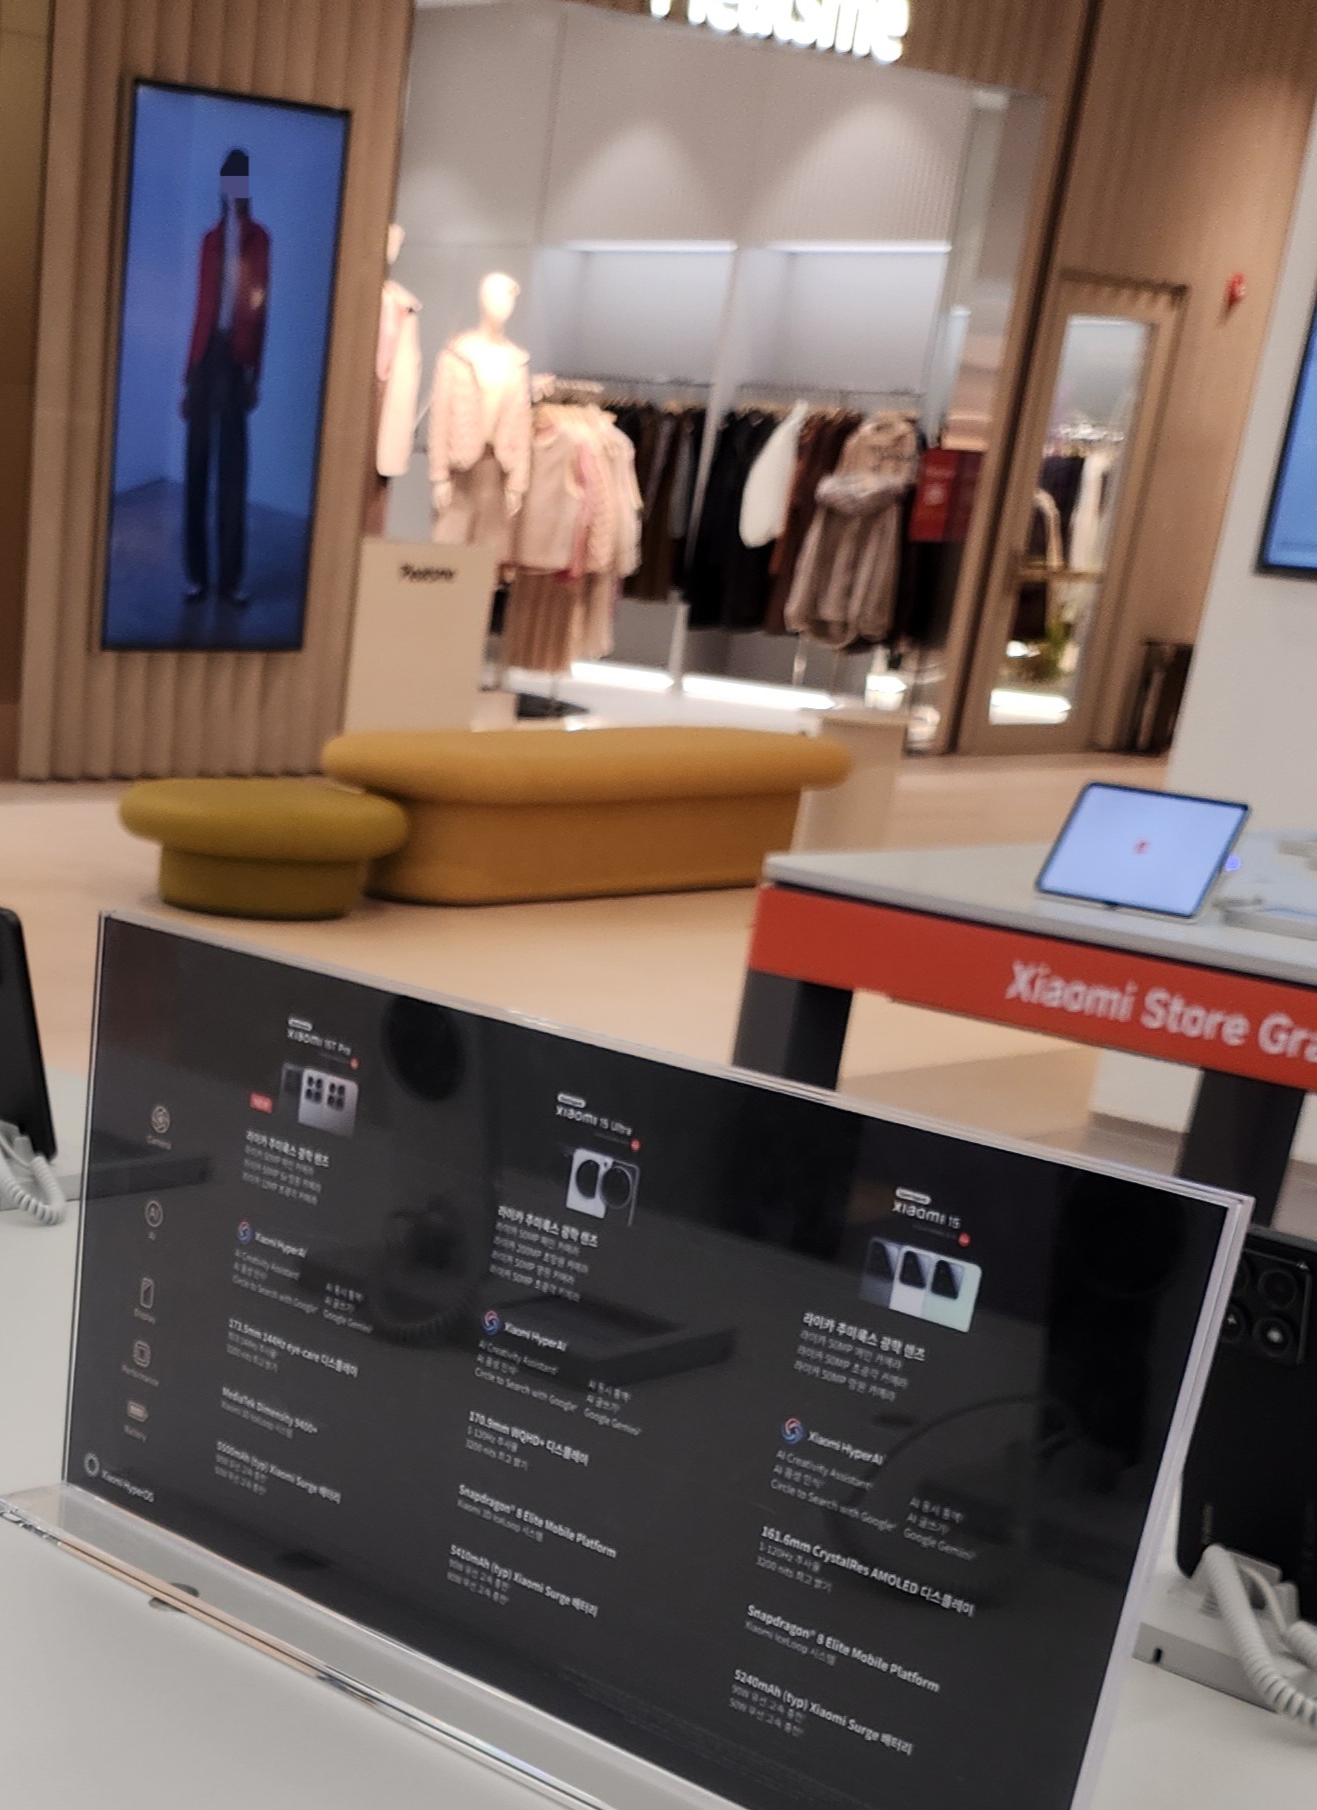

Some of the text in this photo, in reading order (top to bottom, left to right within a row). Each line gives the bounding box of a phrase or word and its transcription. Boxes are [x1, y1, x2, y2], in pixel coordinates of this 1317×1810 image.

[1005, 960, 1136, 1023] Xiaomi
[1140, 988, 1251, 1047] Store
[806, 1429, 841, 1451] Xiaomi
[522, 1509, 544, 1528] Elite
[543, 1518, 576, 1542] Mobile
[574, 1531, 617, 1559] Platform
[760, 1524, 812, 1553] 161.6mm
[811, 1543, 870, 1576] CrystalRes
[868, 1566, 918, 1594] AMOLED
[511, 1571, 544, 1593] Xiaomi
[543, 1584, 571, 1606] Surge
[815, 1632, 825, 1645] 8
[824, 1635, 851, 1656] Elite
[850, 1646, 889, 1672] Mobile
[888, 1662, 940, 1693] Platform
[733, 1668, 782, 1698] 5240mAh
[781, 1689, 809, 1711] (typ)
[807, 1701, 847, 1727] Xiaomi
[846, 1717, 880, 1741] Surge
